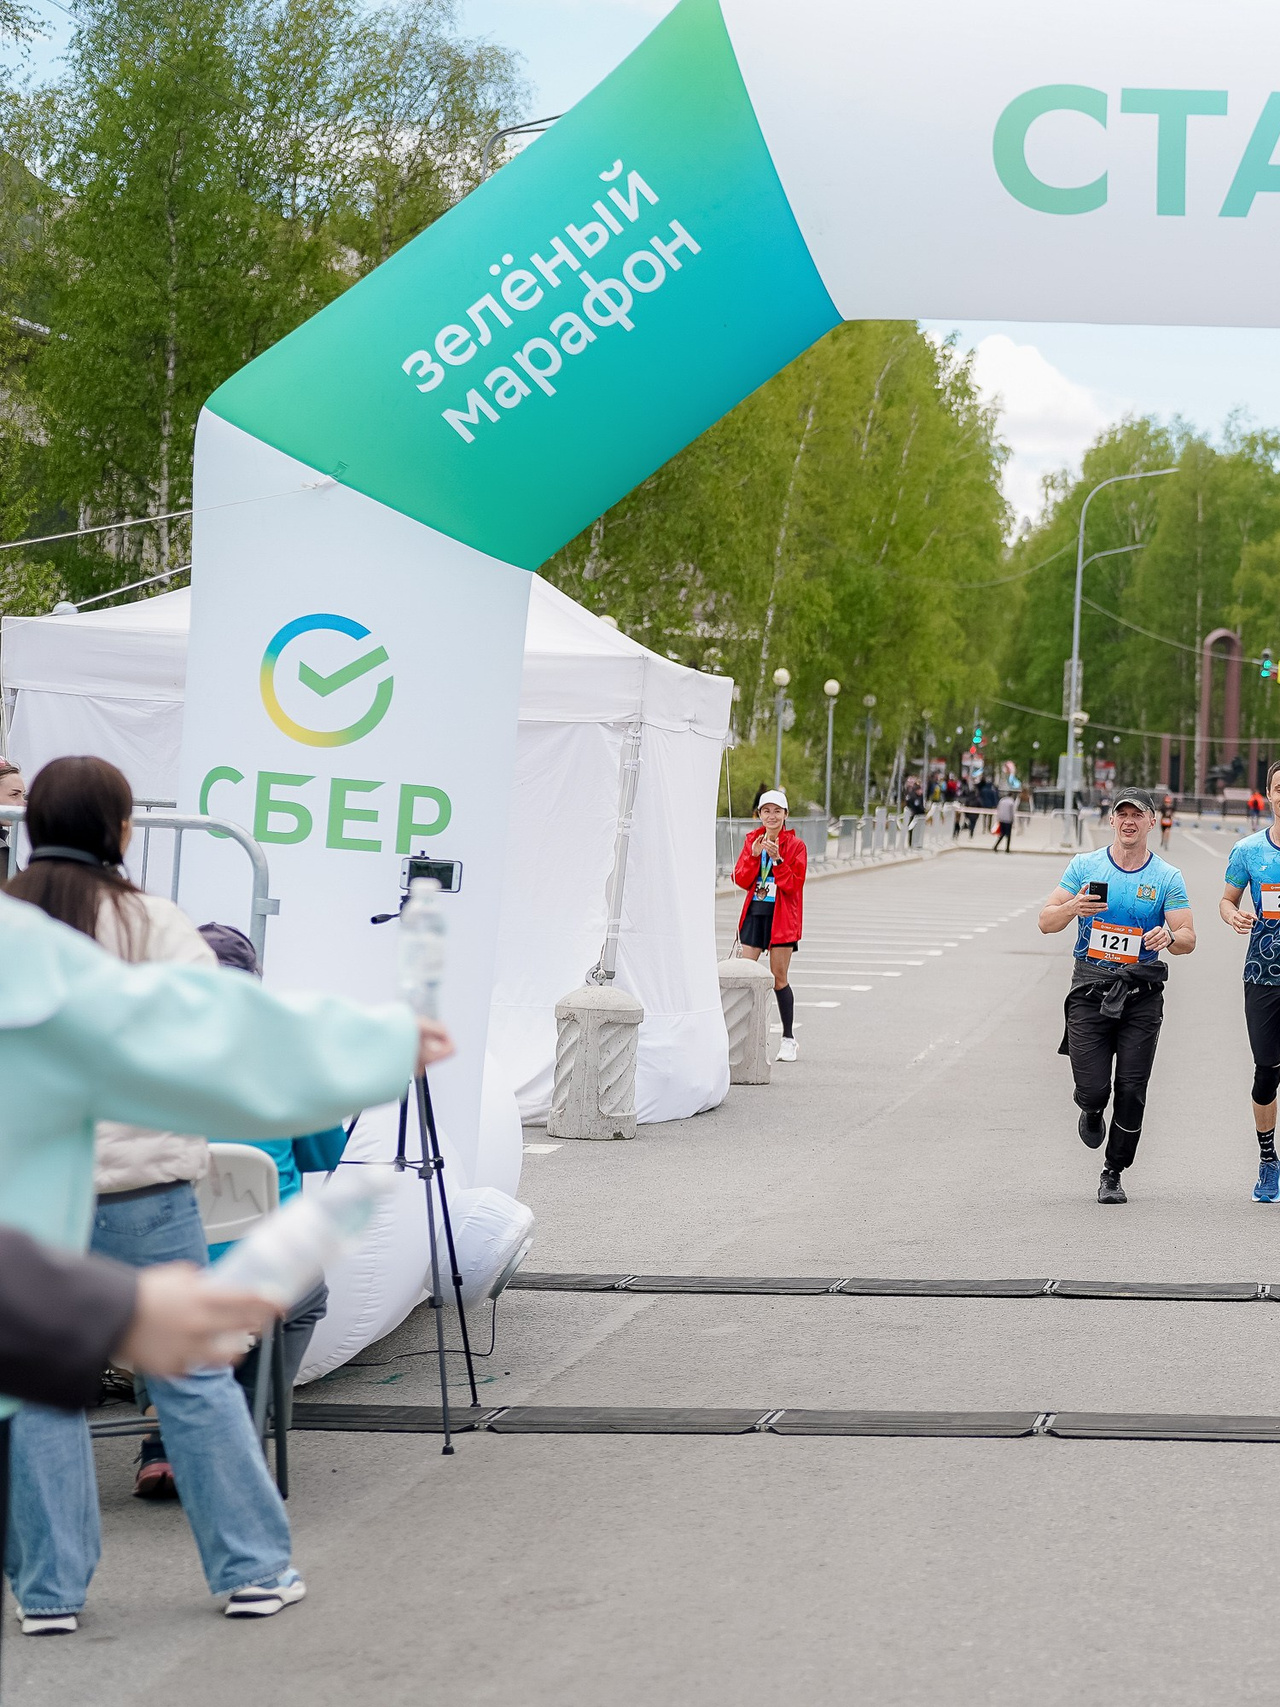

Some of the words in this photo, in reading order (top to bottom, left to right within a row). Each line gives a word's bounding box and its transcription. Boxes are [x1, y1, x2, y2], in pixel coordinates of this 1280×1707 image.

[401, 158, 660, 394] зелёный
[441, 219, 702, 444] марафон
[198, 765, 452, 855] СБЕР
[1100, 933, 1129, 952] 121
